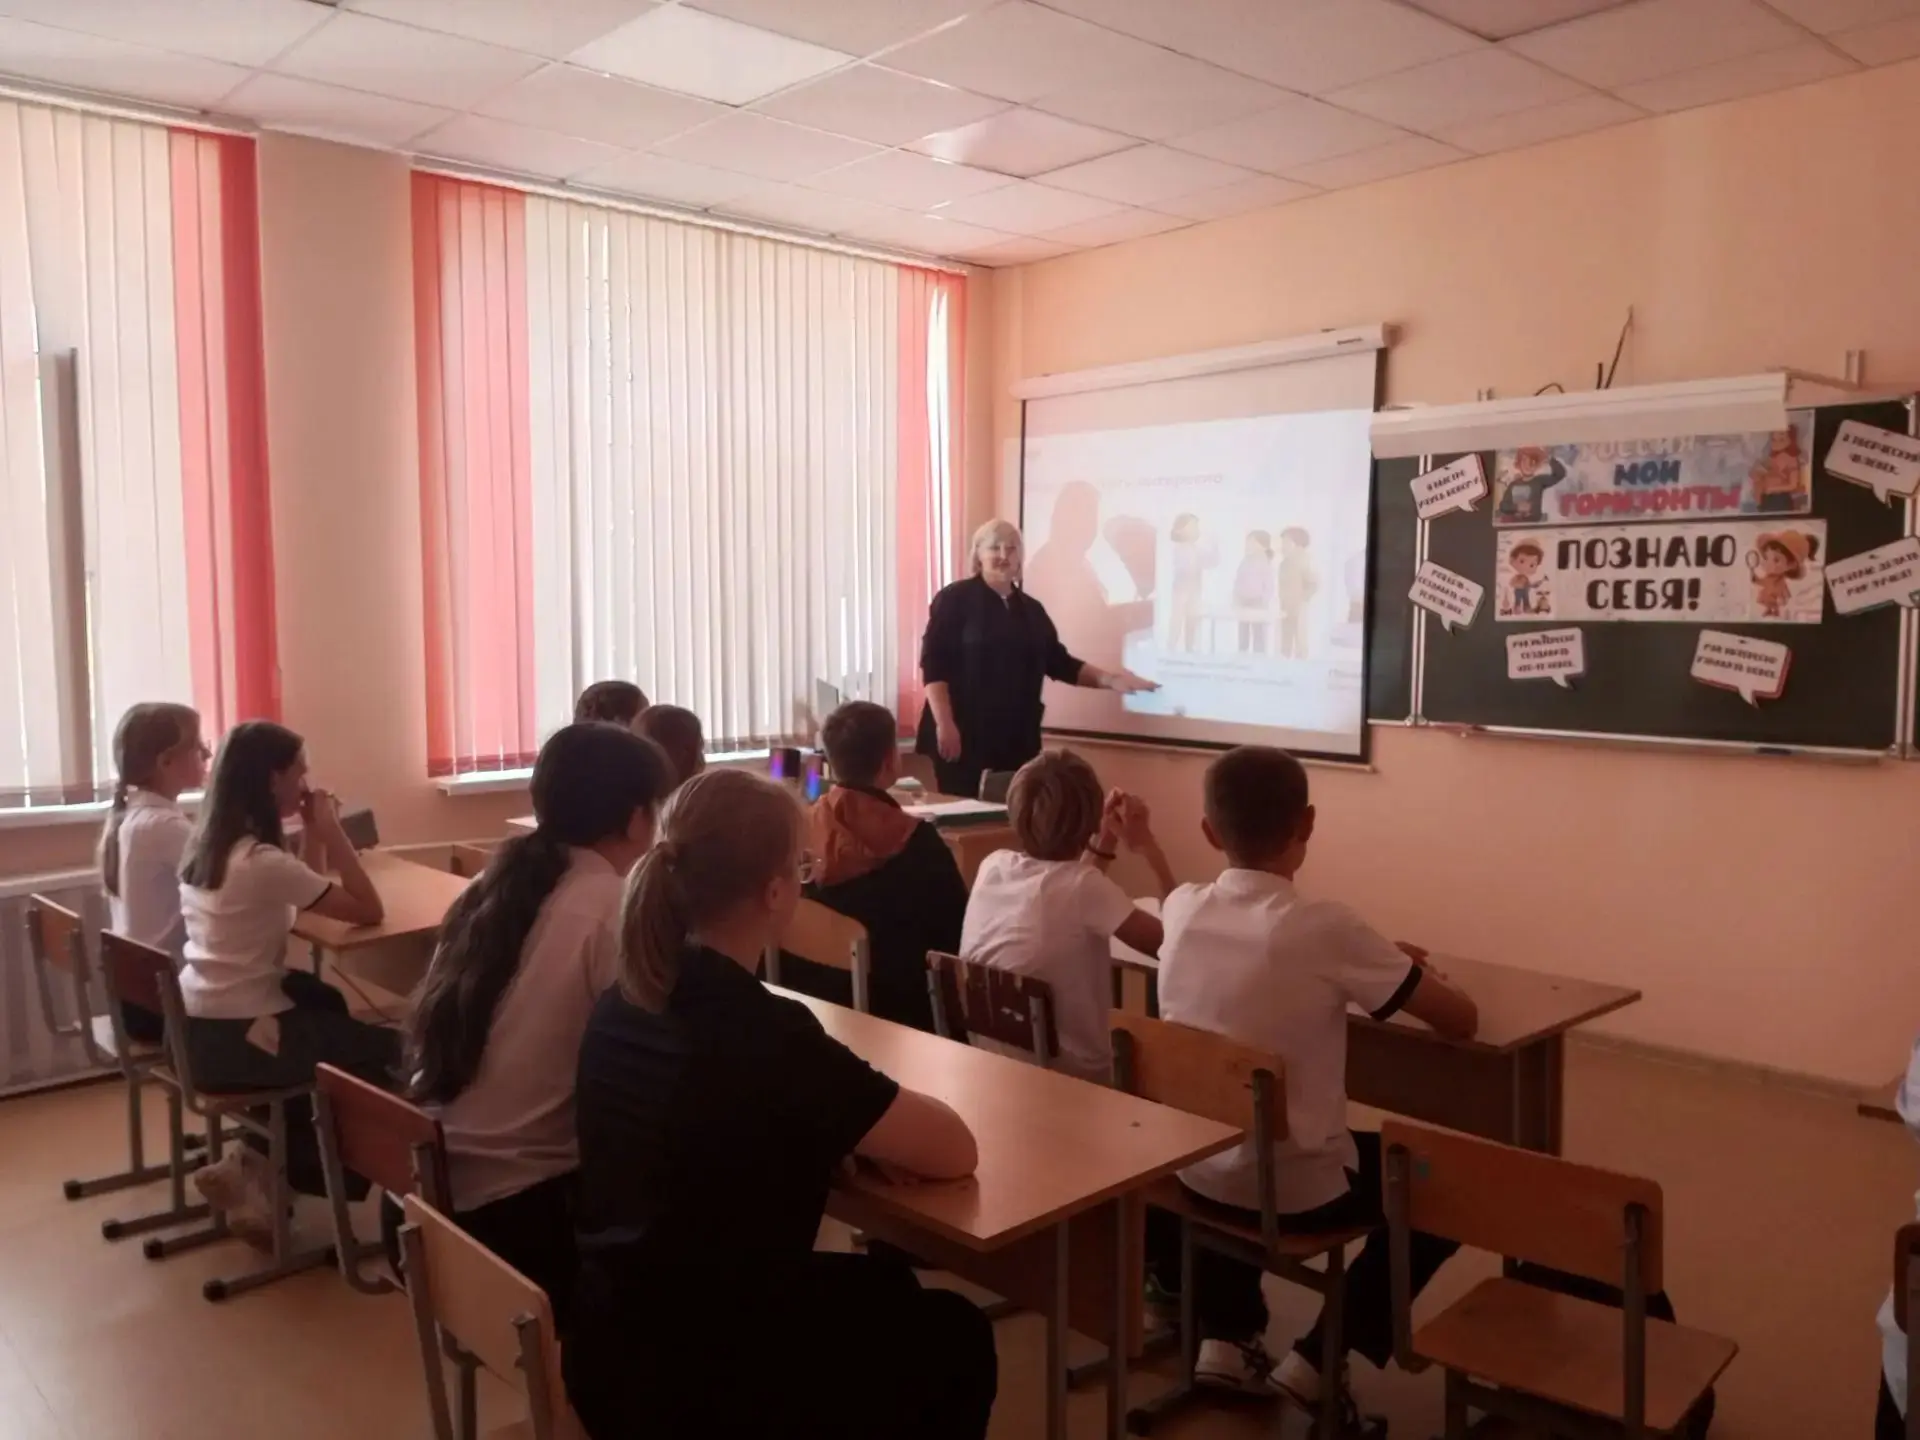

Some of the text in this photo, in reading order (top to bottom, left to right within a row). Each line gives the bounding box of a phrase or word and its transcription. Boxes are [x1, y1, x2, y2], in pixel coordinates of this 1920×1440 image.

[1614, 461, 1680, 485] МОИ
[1562, 487, 1740, 515] ГОРИЗОНТЫ
[1557, 534, 1736, 570] ПОЗНАЮ
[1587, 577, 1701, 611] СЕБЯ!
